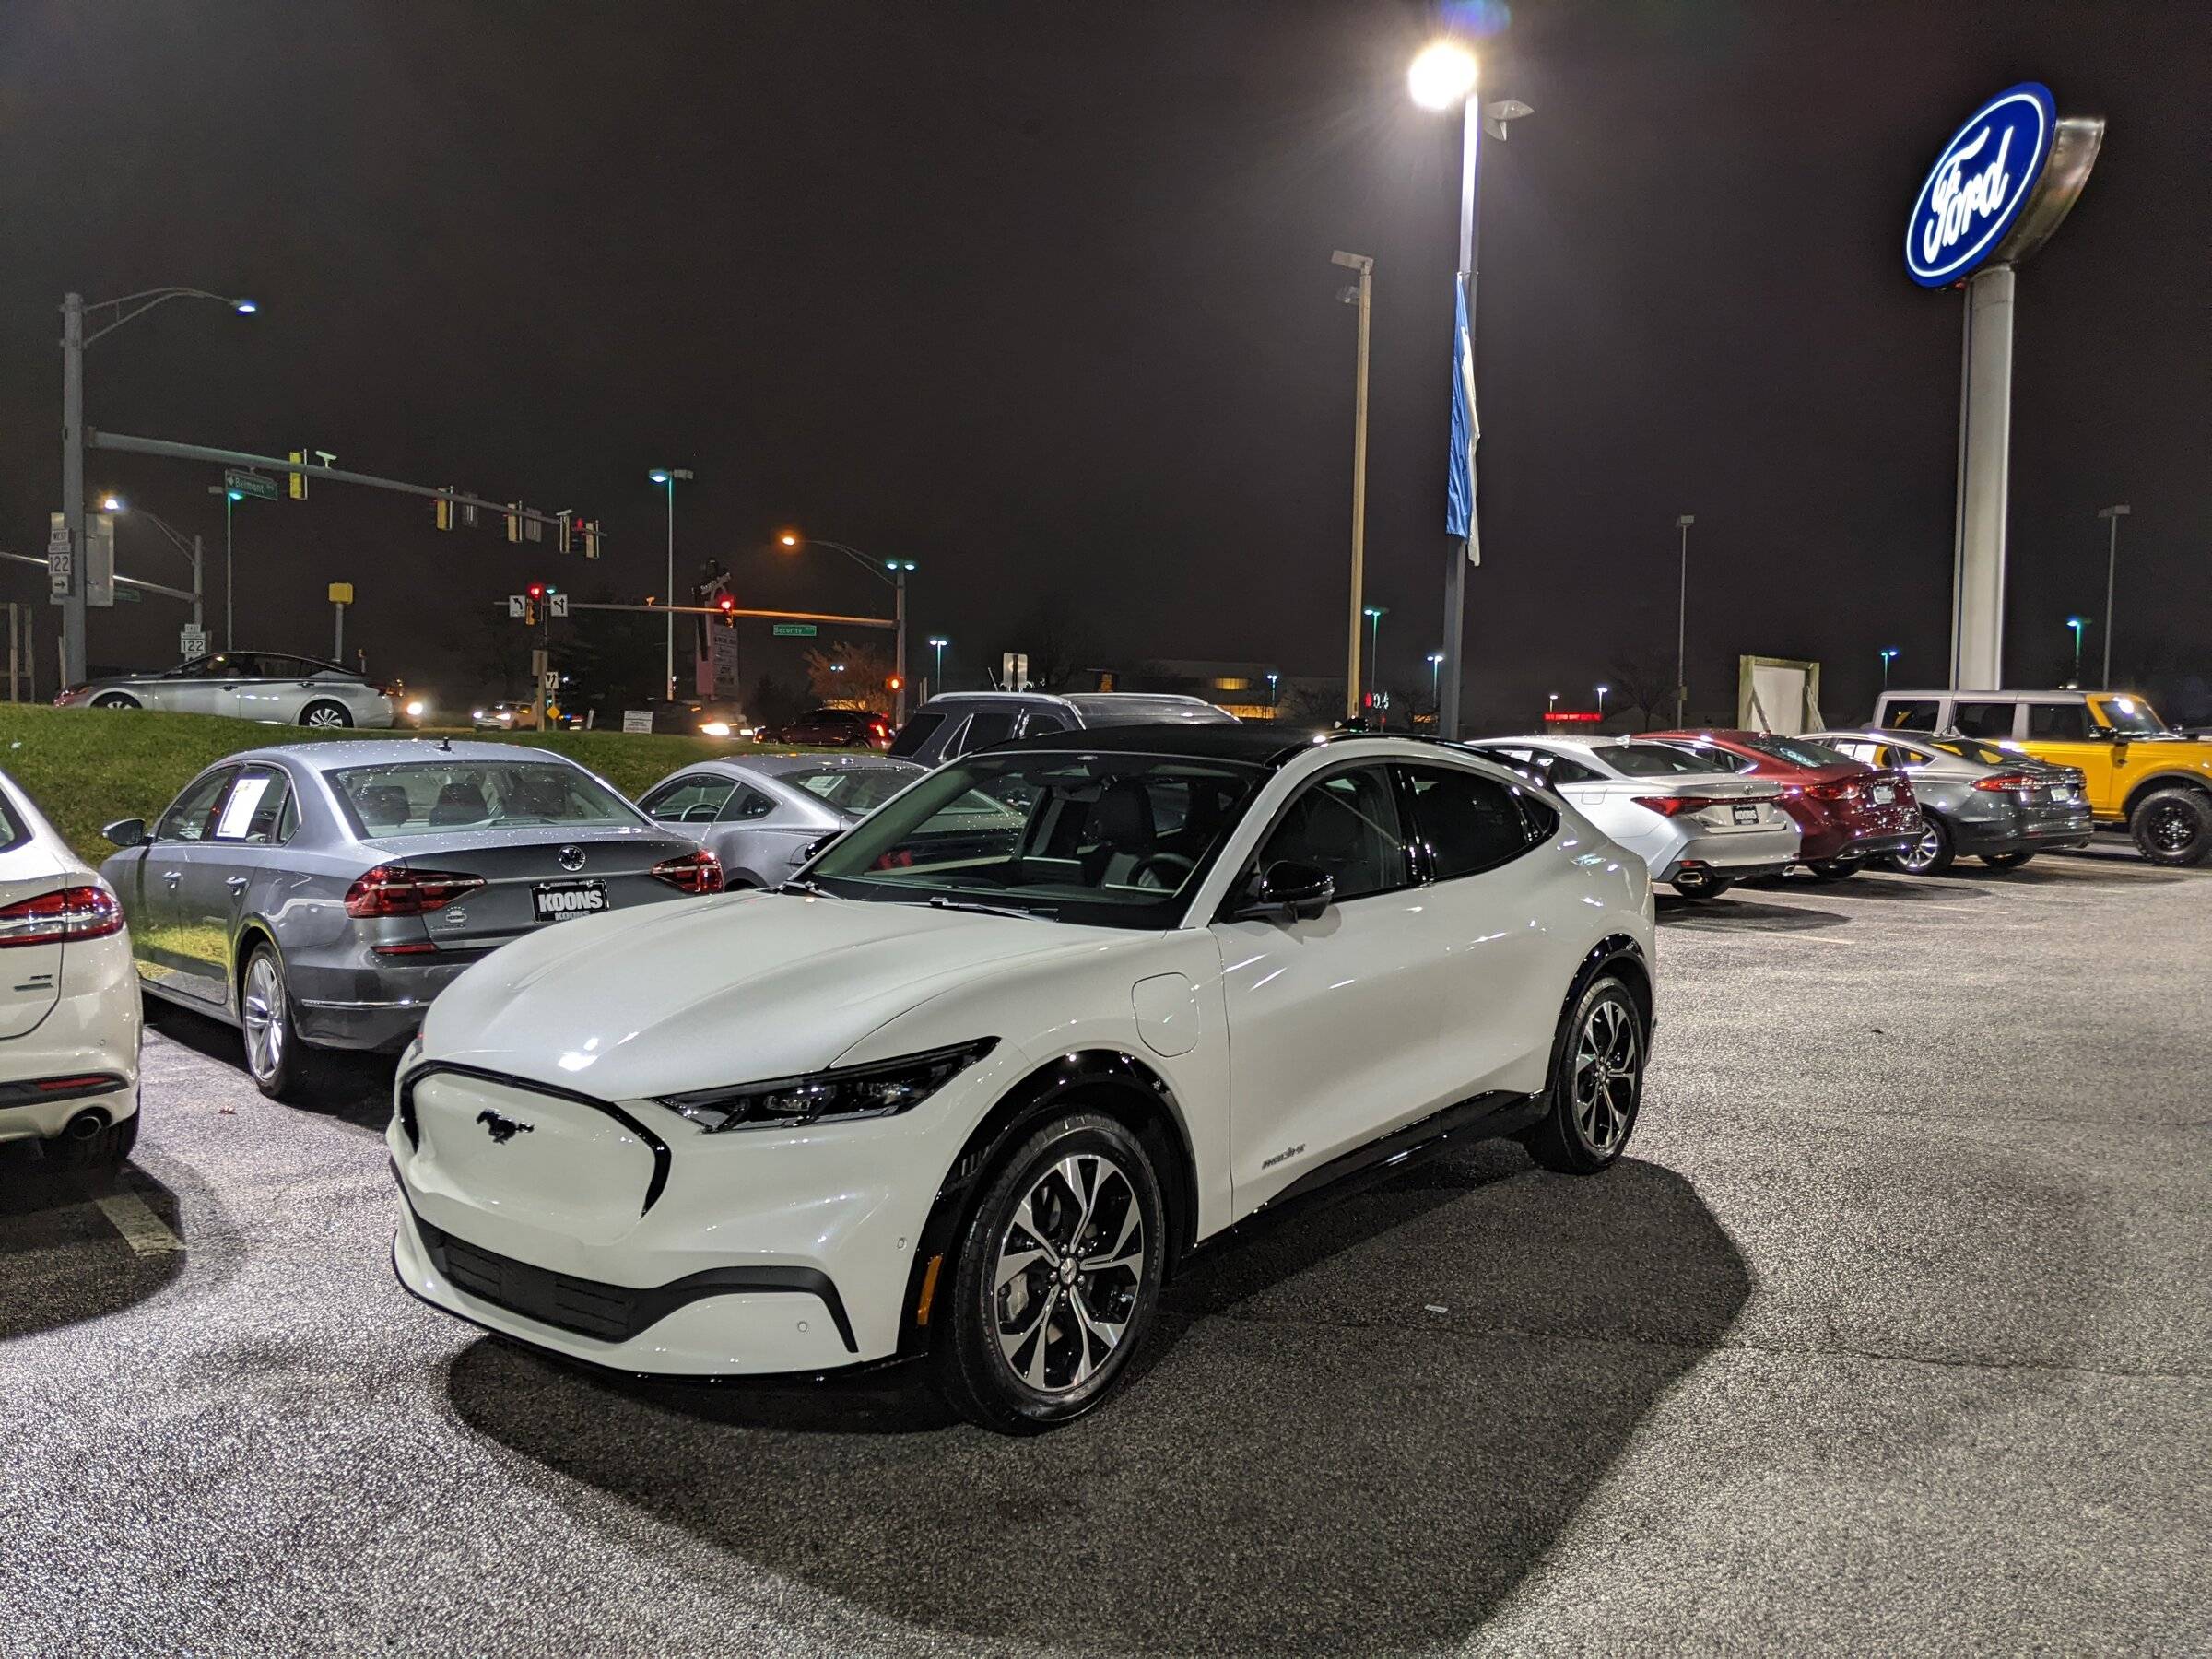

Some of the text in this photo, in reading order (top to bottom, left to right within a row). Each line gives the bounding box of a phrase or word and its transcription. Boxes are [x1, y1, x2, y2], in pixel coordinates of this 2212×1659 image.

[1924, 125, 2014, 264] Ford
[50, 556, 69, 571] 122
[182, 641, 203, 652] 122
[538, 890, 603, 912] KOONS
